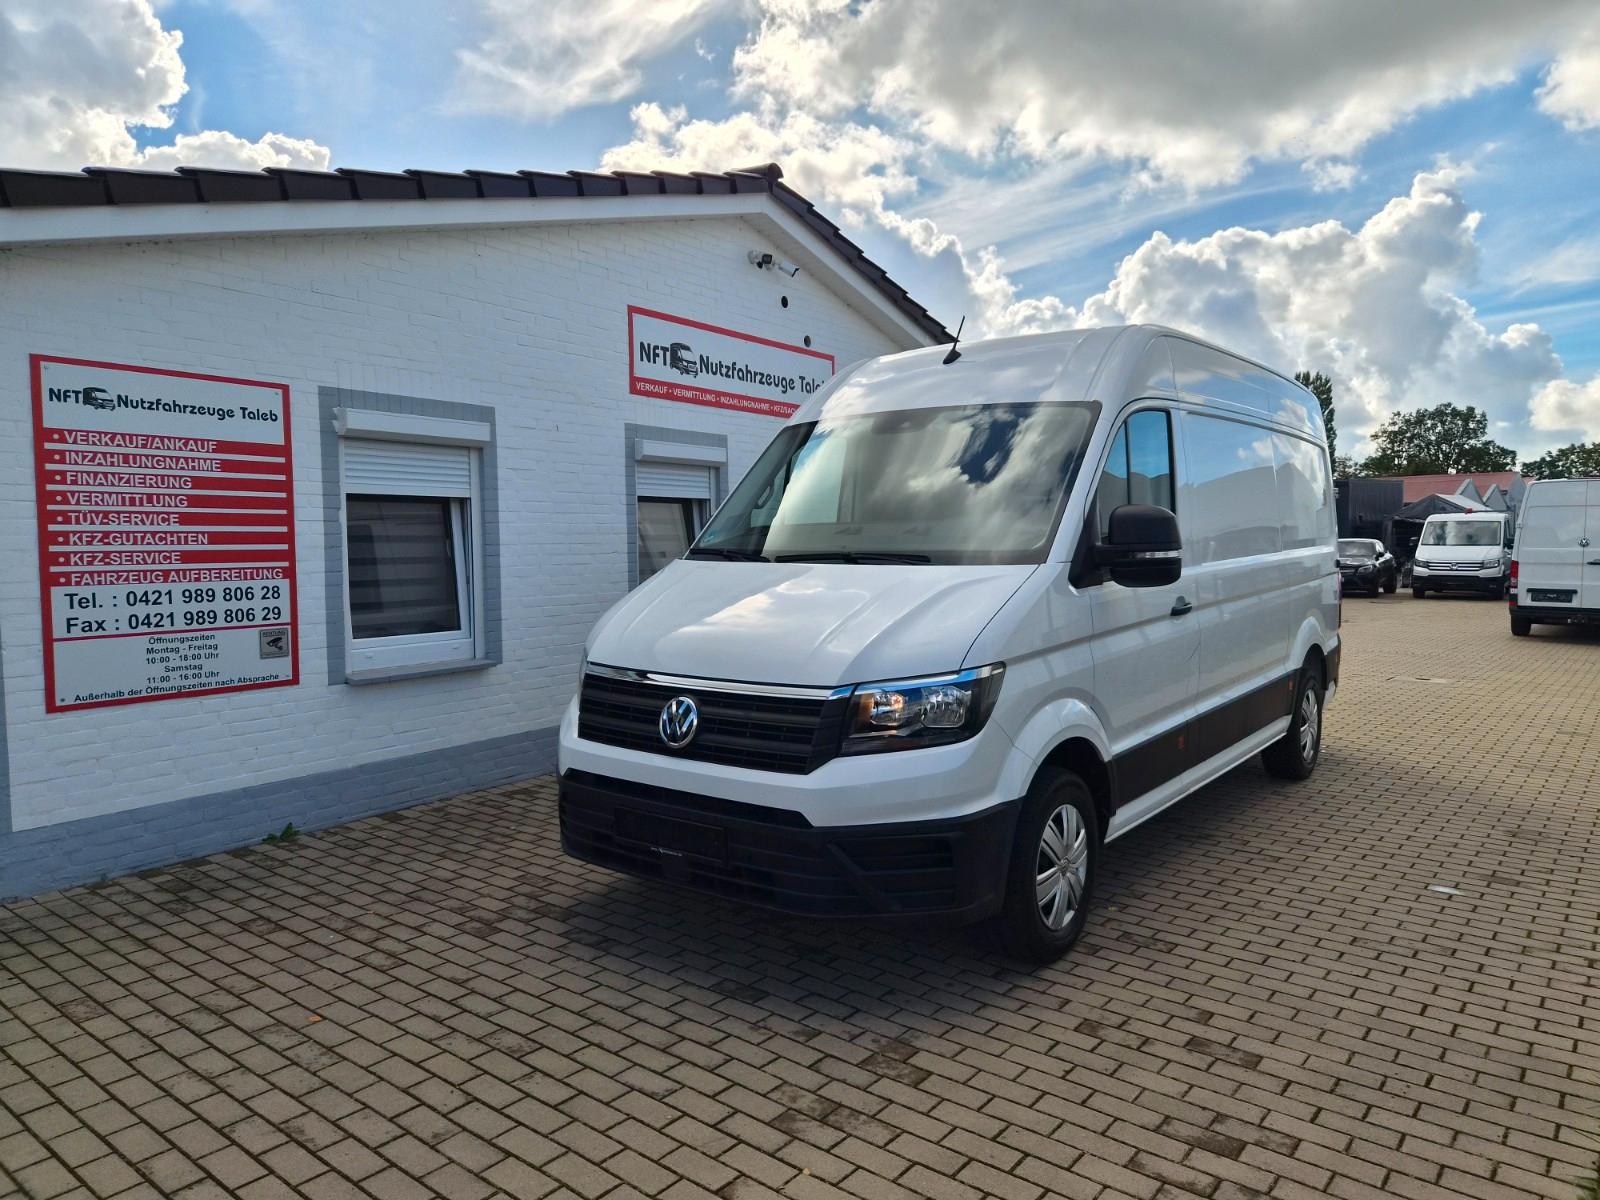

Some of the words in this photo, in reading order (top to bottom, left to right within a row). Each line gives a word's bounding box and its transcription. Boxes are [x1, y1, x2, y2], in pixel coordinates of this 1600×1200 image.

[640, 341, 670, 366] NFT
[699, 354, 796, 394] Nutzfahrzeuge
[799, 376, 825, 394] Tal
[635, 381, 668, 395] VERKAUF
[673, 388, 716, 402] VERMITTLUNG
[49, 387, 83, 404] NFT
[117, 394, 235, 421] Nutzfahrzeuge
[240, 406, 278, 422] Taleb
[64, 431, 218, 453] VERKAUF/ANKAUF
[65, 452, 221, 472] INZAHLUNGNAHME
[66, 472, 192, 489] FINANZIERUNG
[67, 492, 188, 508] VERMITTLUNG
[68, 510, 180, 526] TÜV-SERVICE
[69, 533, 208, 546] KFZ-GUTACHTEN
[70, 552, 181, 566] KFZ-SERVICE
[71, 572, 164, 586] FAHRZEUG
[168, 568, 283, 583] AUFBEREITUNG
[64, 592, 103, 610] Tel.
[126, 590, 173, 607] 0421
[182, 588, 216, 604] 989
[222, 586, 255, 602] 806
[261, 585, 281, 600] 28
[66, 616, 107, 634] Fax
[128, 612, 175, 630] 0421
[183, 609, 217, 626] 989
[224, 607, 256, 623] 806
[261, 606, 282, 621] 29
[148, 634, 215, 645] Öffnungszeiten
[146, 646, 180, 655] Montag
[188, 643, 218, 652] Freitag
[146, 655, 170, 665] 10:00
[204, 651, 219, 660] Uhr
[164, 663, 203, 673] Samstag
[147, 675, 171, 684] 11:00
[179, 672, 202, 682] 16:00
[204, 670, 220, 679] Uhr
[74, 689, 125, 703] Außerhalb
[127, 687, 143, 697] der
[215, 678, 235, 687] nach
[237, 673, 279, 685] Absprache
